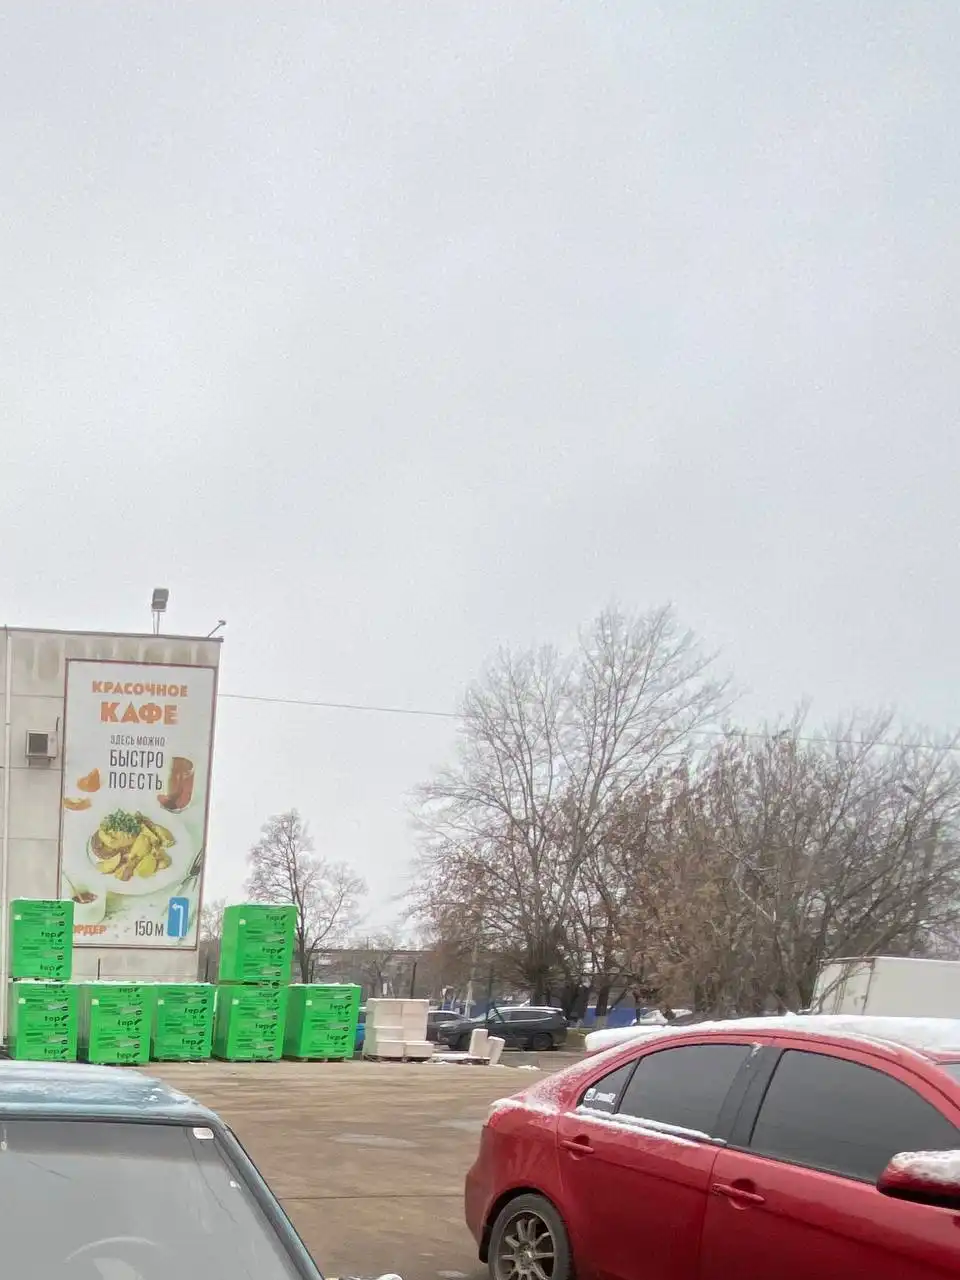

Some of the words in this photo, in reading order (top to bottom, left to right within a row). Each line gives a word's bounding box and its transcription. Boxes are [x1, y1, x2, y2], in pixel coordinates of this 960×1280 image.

[92, 680, 188, 697] КРАСОЧНОЕ
[100, 701, 178, 725] КАФЕ
[110, 734, 135, 745] ЗДЕСЬ
[136, 735, 165, 747] МОЖНО
[110, 749, 164, 769] БЫСТРО
[108, 771, 163, 790] ПОЕСТЬ
[135, 920, 153, 936] 150
